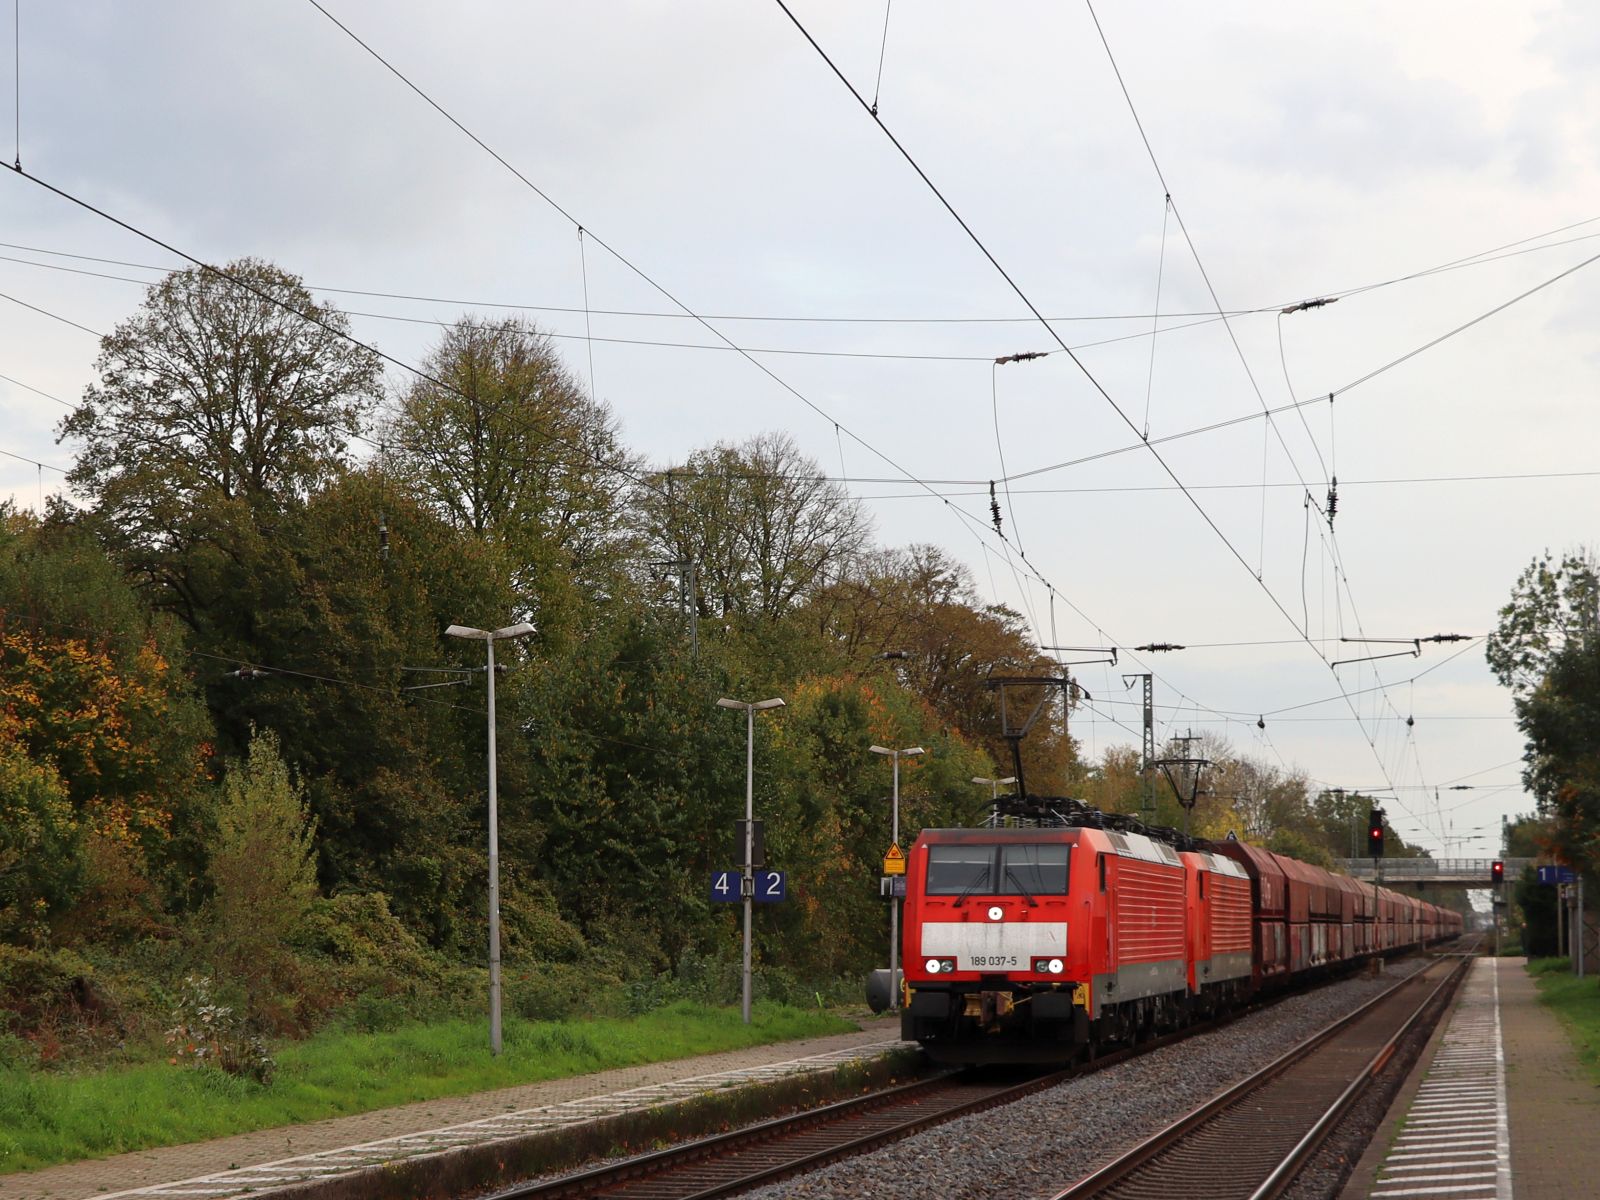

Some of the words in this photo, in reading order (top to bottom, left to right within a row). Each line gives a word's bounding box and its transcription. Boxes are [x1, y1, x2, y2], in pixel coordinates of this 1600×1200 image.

[1539, 867, 1547, 881] 1
[714, 872, 730, 895] 4
[766, 872, 781, 895] 2
[970, 956, 987, 966] 189
[988, 956, 1017, 966] 037-5
